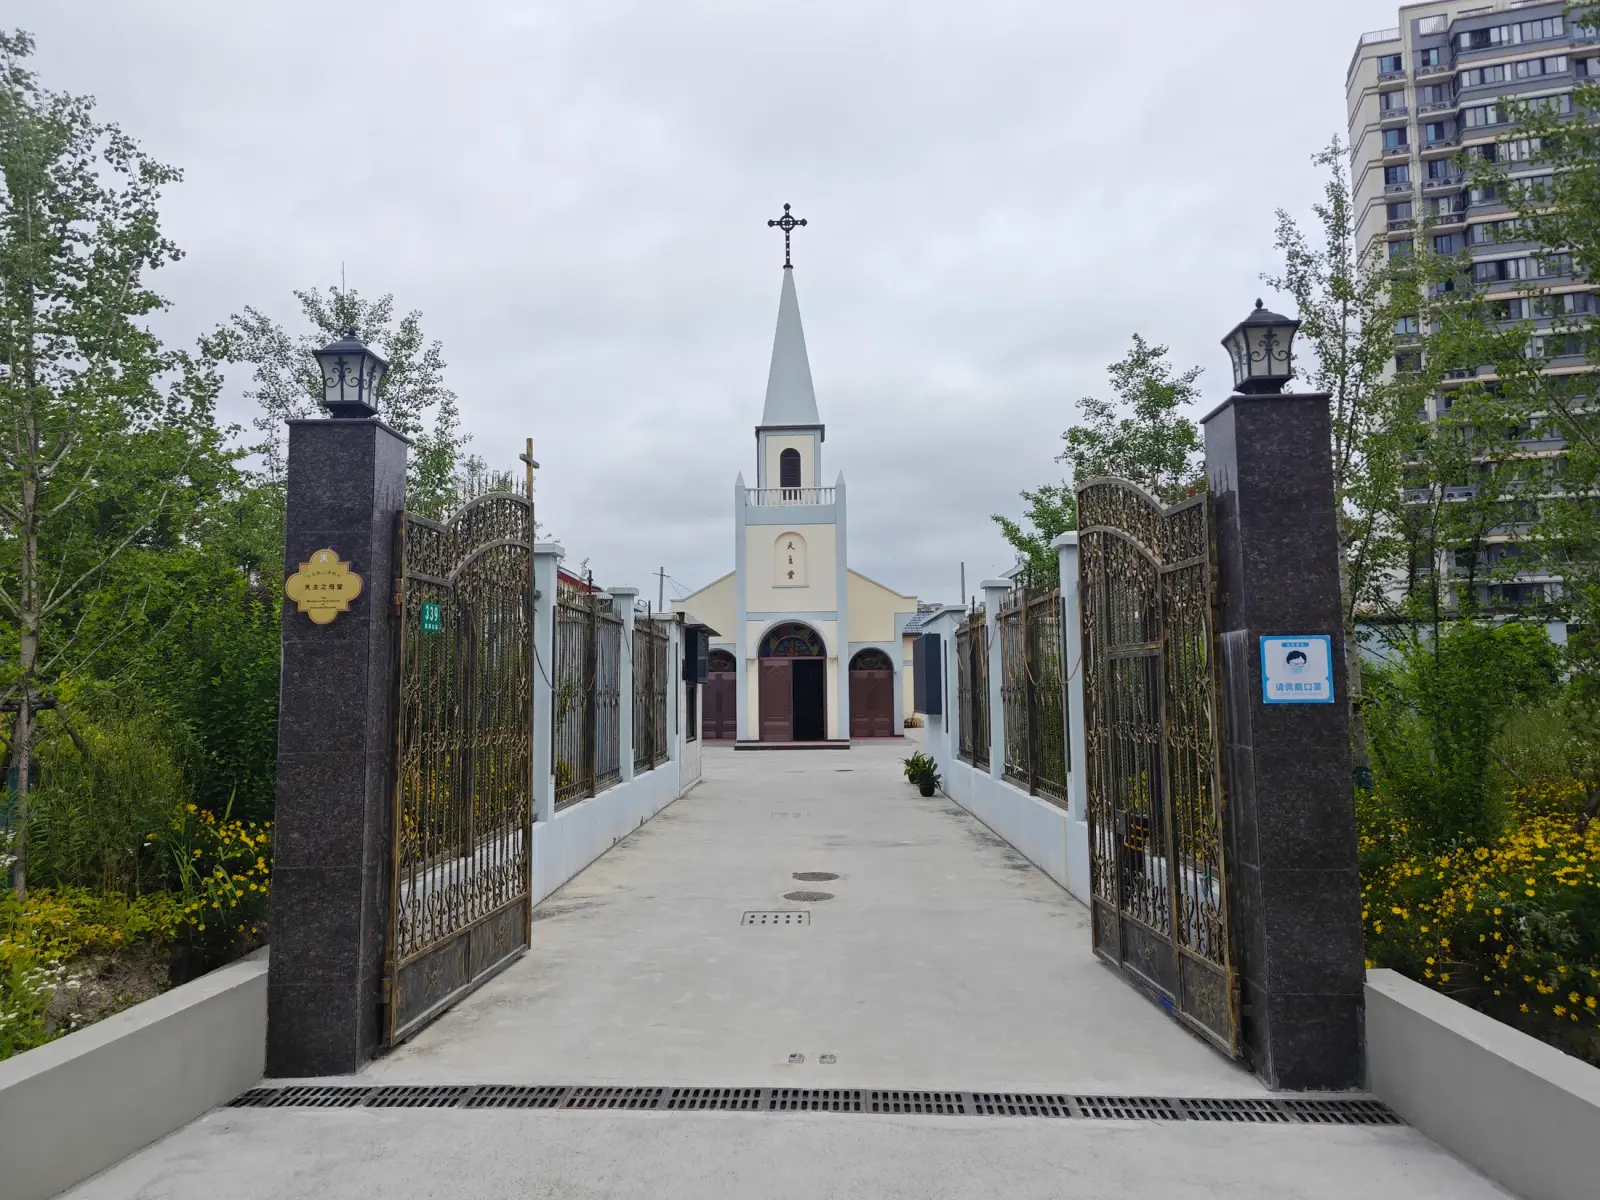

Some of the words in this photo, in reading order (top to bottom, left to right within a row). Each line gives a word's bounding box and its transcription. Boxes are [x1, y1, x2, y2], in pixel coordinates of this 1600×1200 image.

[787, 541, 795, 580] 天主堂
[304, 583, 344, 591] 天主之母堂
[425, 605, 438, 621] 339
[1275, 682, 1322, 692] 请佩戴口罩
